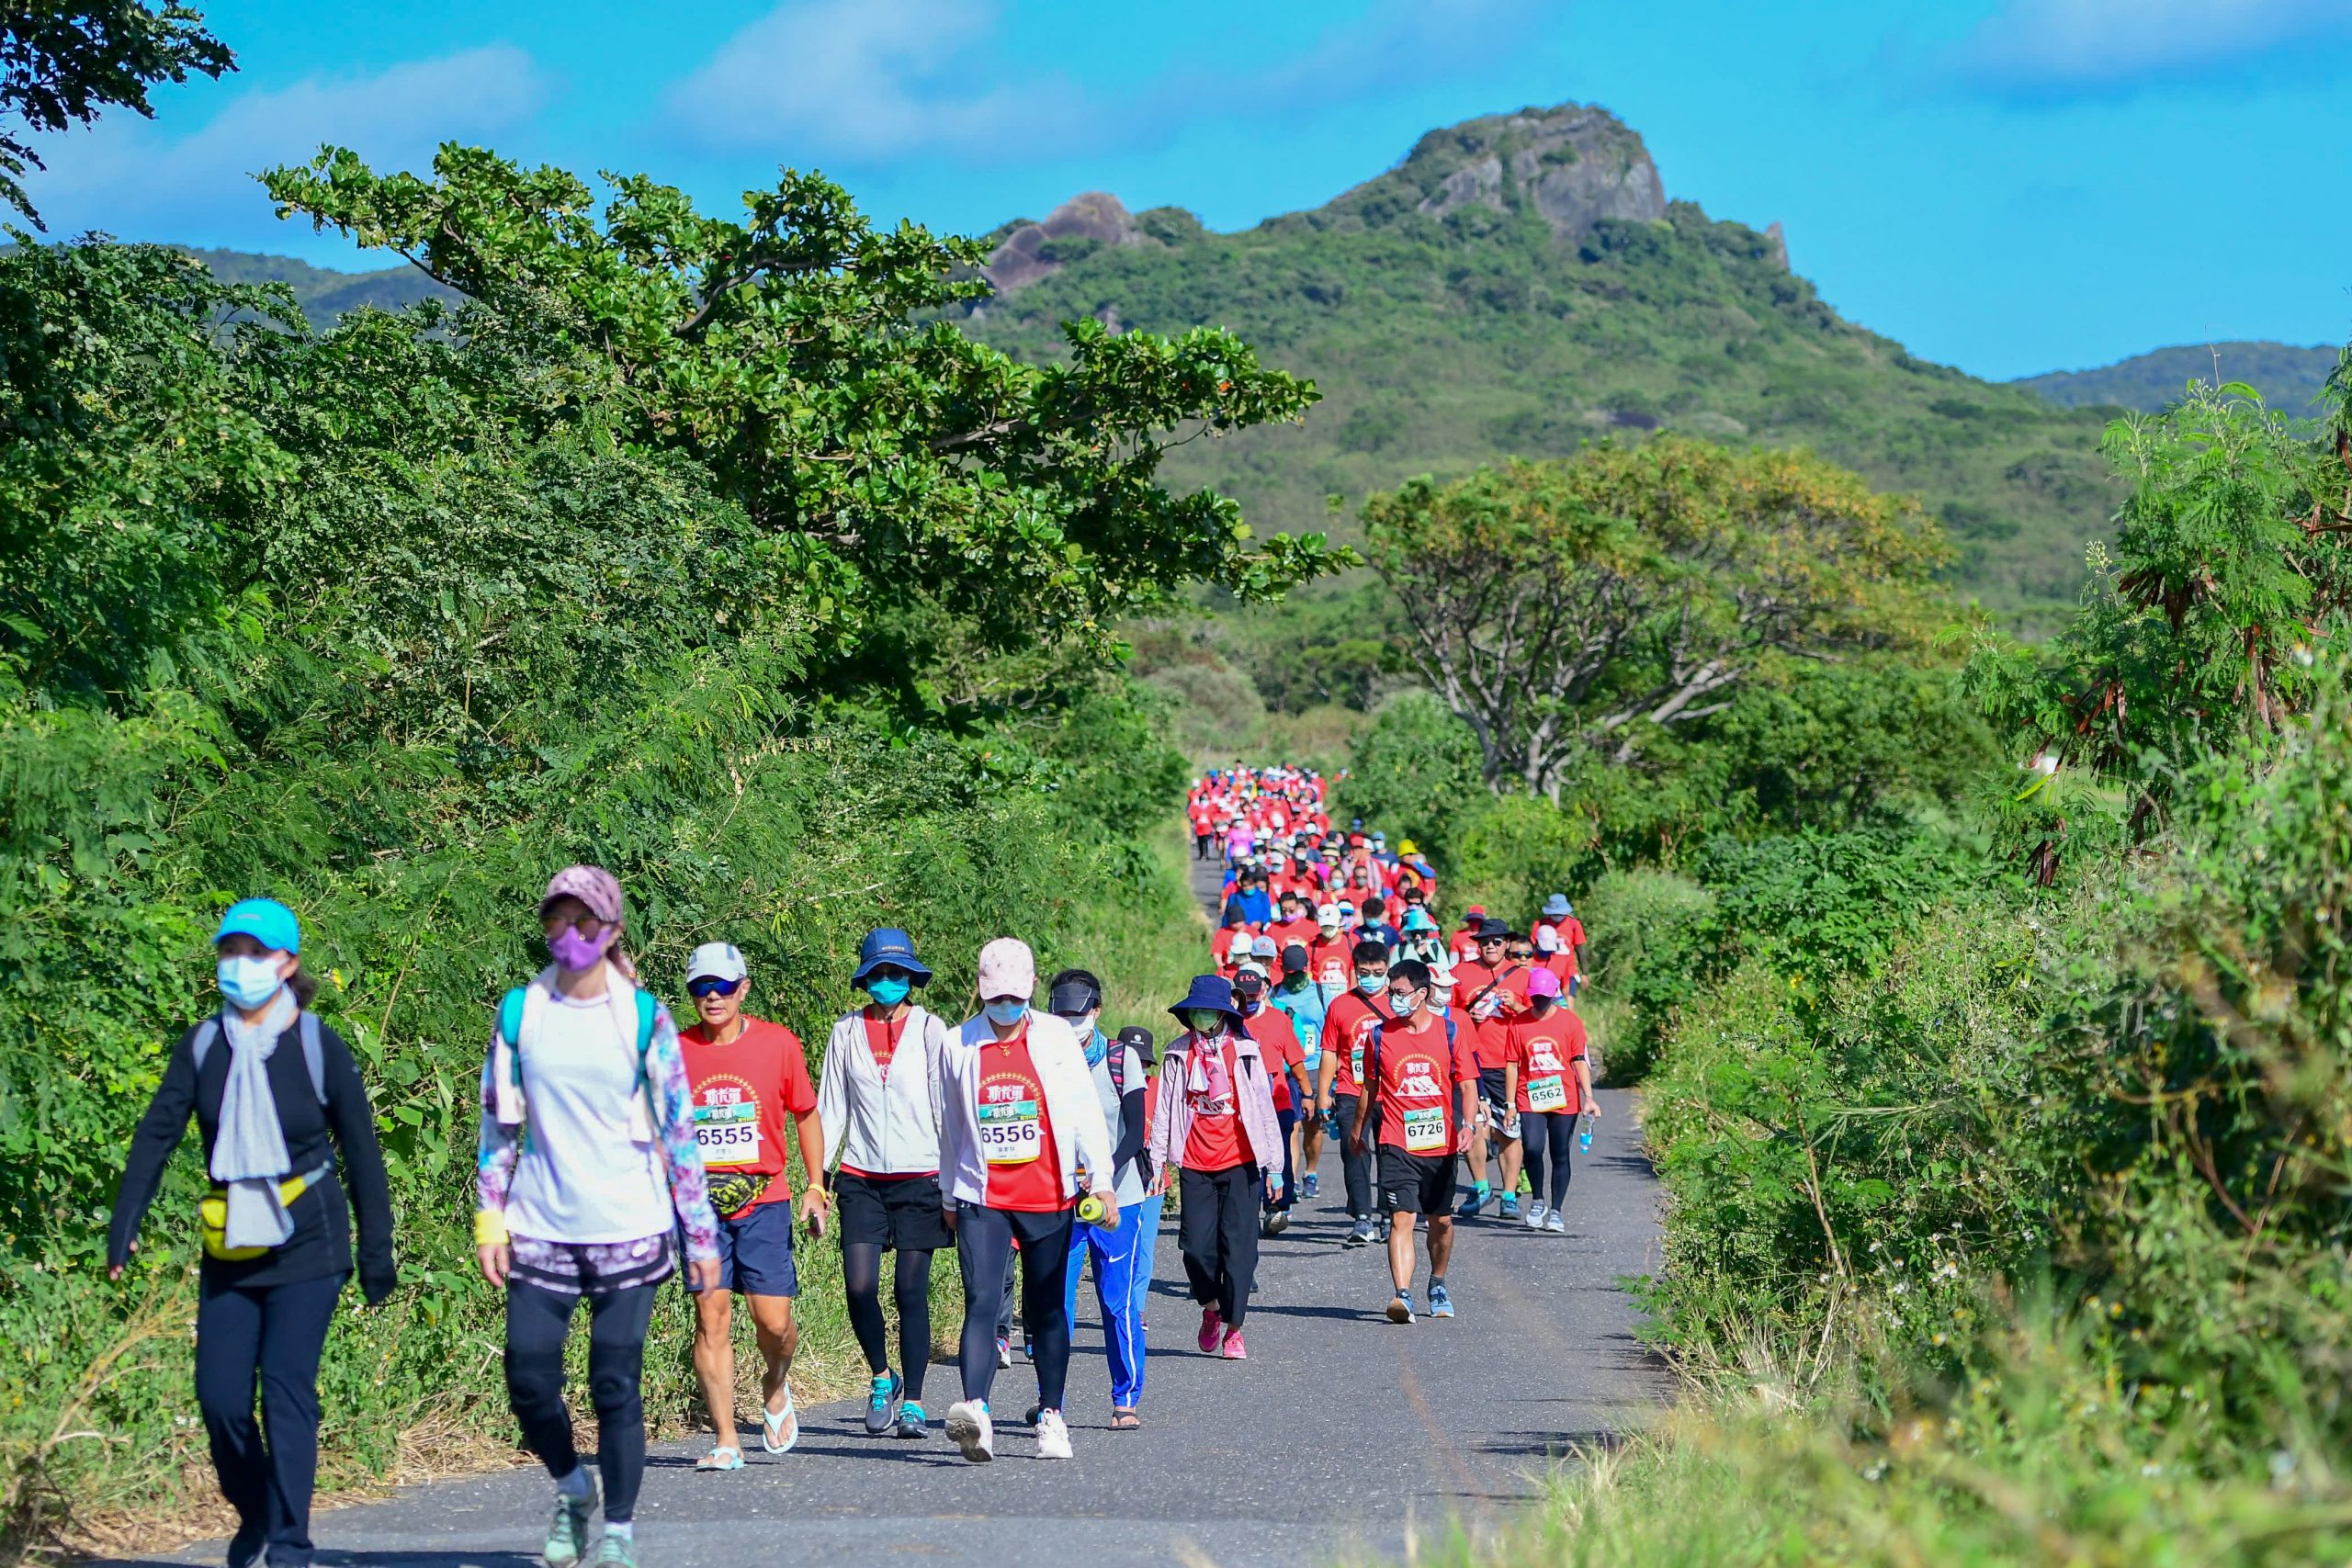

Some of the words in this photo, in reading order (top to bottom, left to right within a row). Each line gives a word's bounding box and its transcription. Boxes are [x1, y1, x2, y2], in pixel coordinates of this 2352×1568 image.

[1532, 1088, 1563, 1102] 6562
[695, 1125, 752, 1145] 6555
[981, 1123, 1035, 1144] 6556
[1408, 1122, 1443, 1137] 6726
